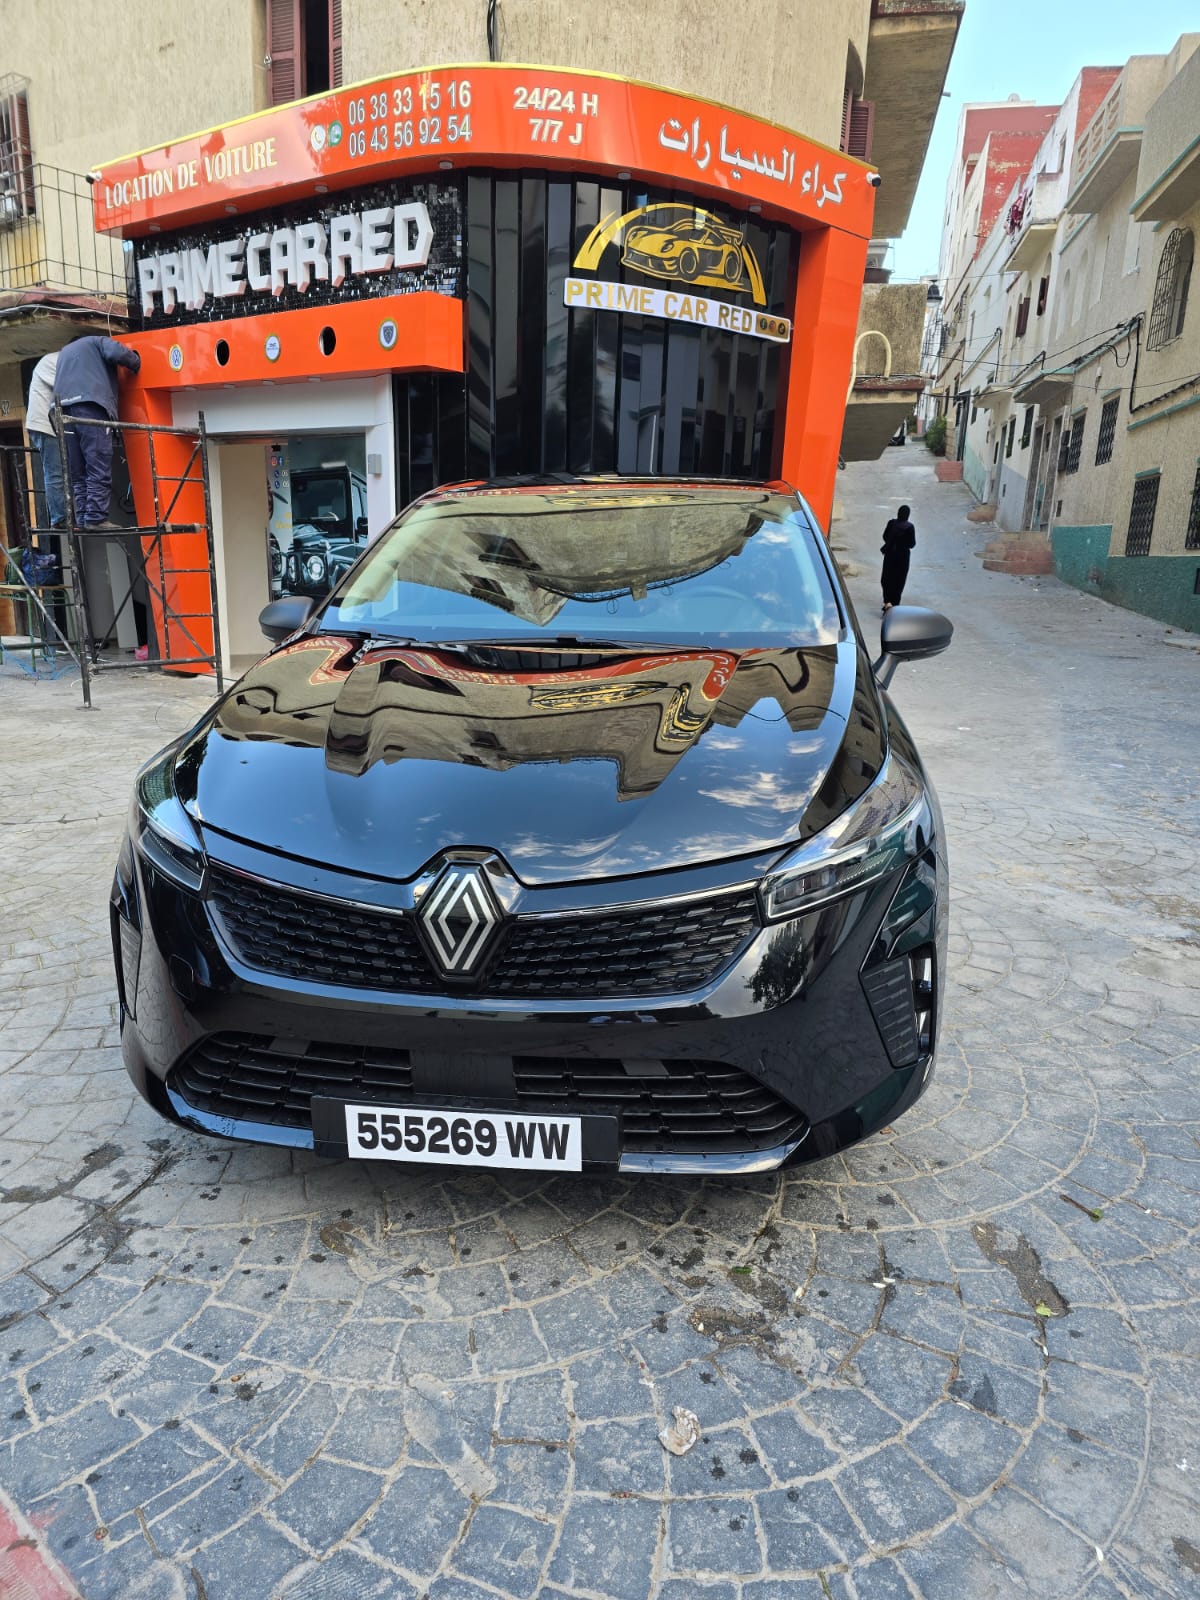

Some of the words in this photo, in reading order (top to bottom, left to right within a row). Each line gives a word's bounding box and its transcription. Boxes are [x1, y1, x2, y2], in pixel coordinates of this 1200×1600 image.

[348, 99, 365, 126] 06
[370, 92, 388, 121] 38
[393, 86, 413, 116] 33
[419, 82, 441, 112] 15
[447, 80, 472, 108] 16
[513, 86, 576, 114] 24/24
[581, 92, 599, 117] H
[349, 130, 366, 158] 06
[370, 124, 389, 152] 43
[394, 120, 413, 150] 56
[419, 117, 442, 146] 92
[447, 114, 472, 142] 54
[529, 117, 564, 143] 7/7
[568, 122, 583, 146] J
[105, 167, 173, 209] LOCATION
[177, 159, 199, 190] DE
[204, 137, 278, 183] VOITURE
[801, 162, 848, 208] كراء
[567, 280, 655, 314] PRIME
[664, 293, 708, 324] CAR
[718, 304, 753, 334] RED
[357, 1112, 497, 1157] 555269
[505, 1120, 571, 1161] WW
